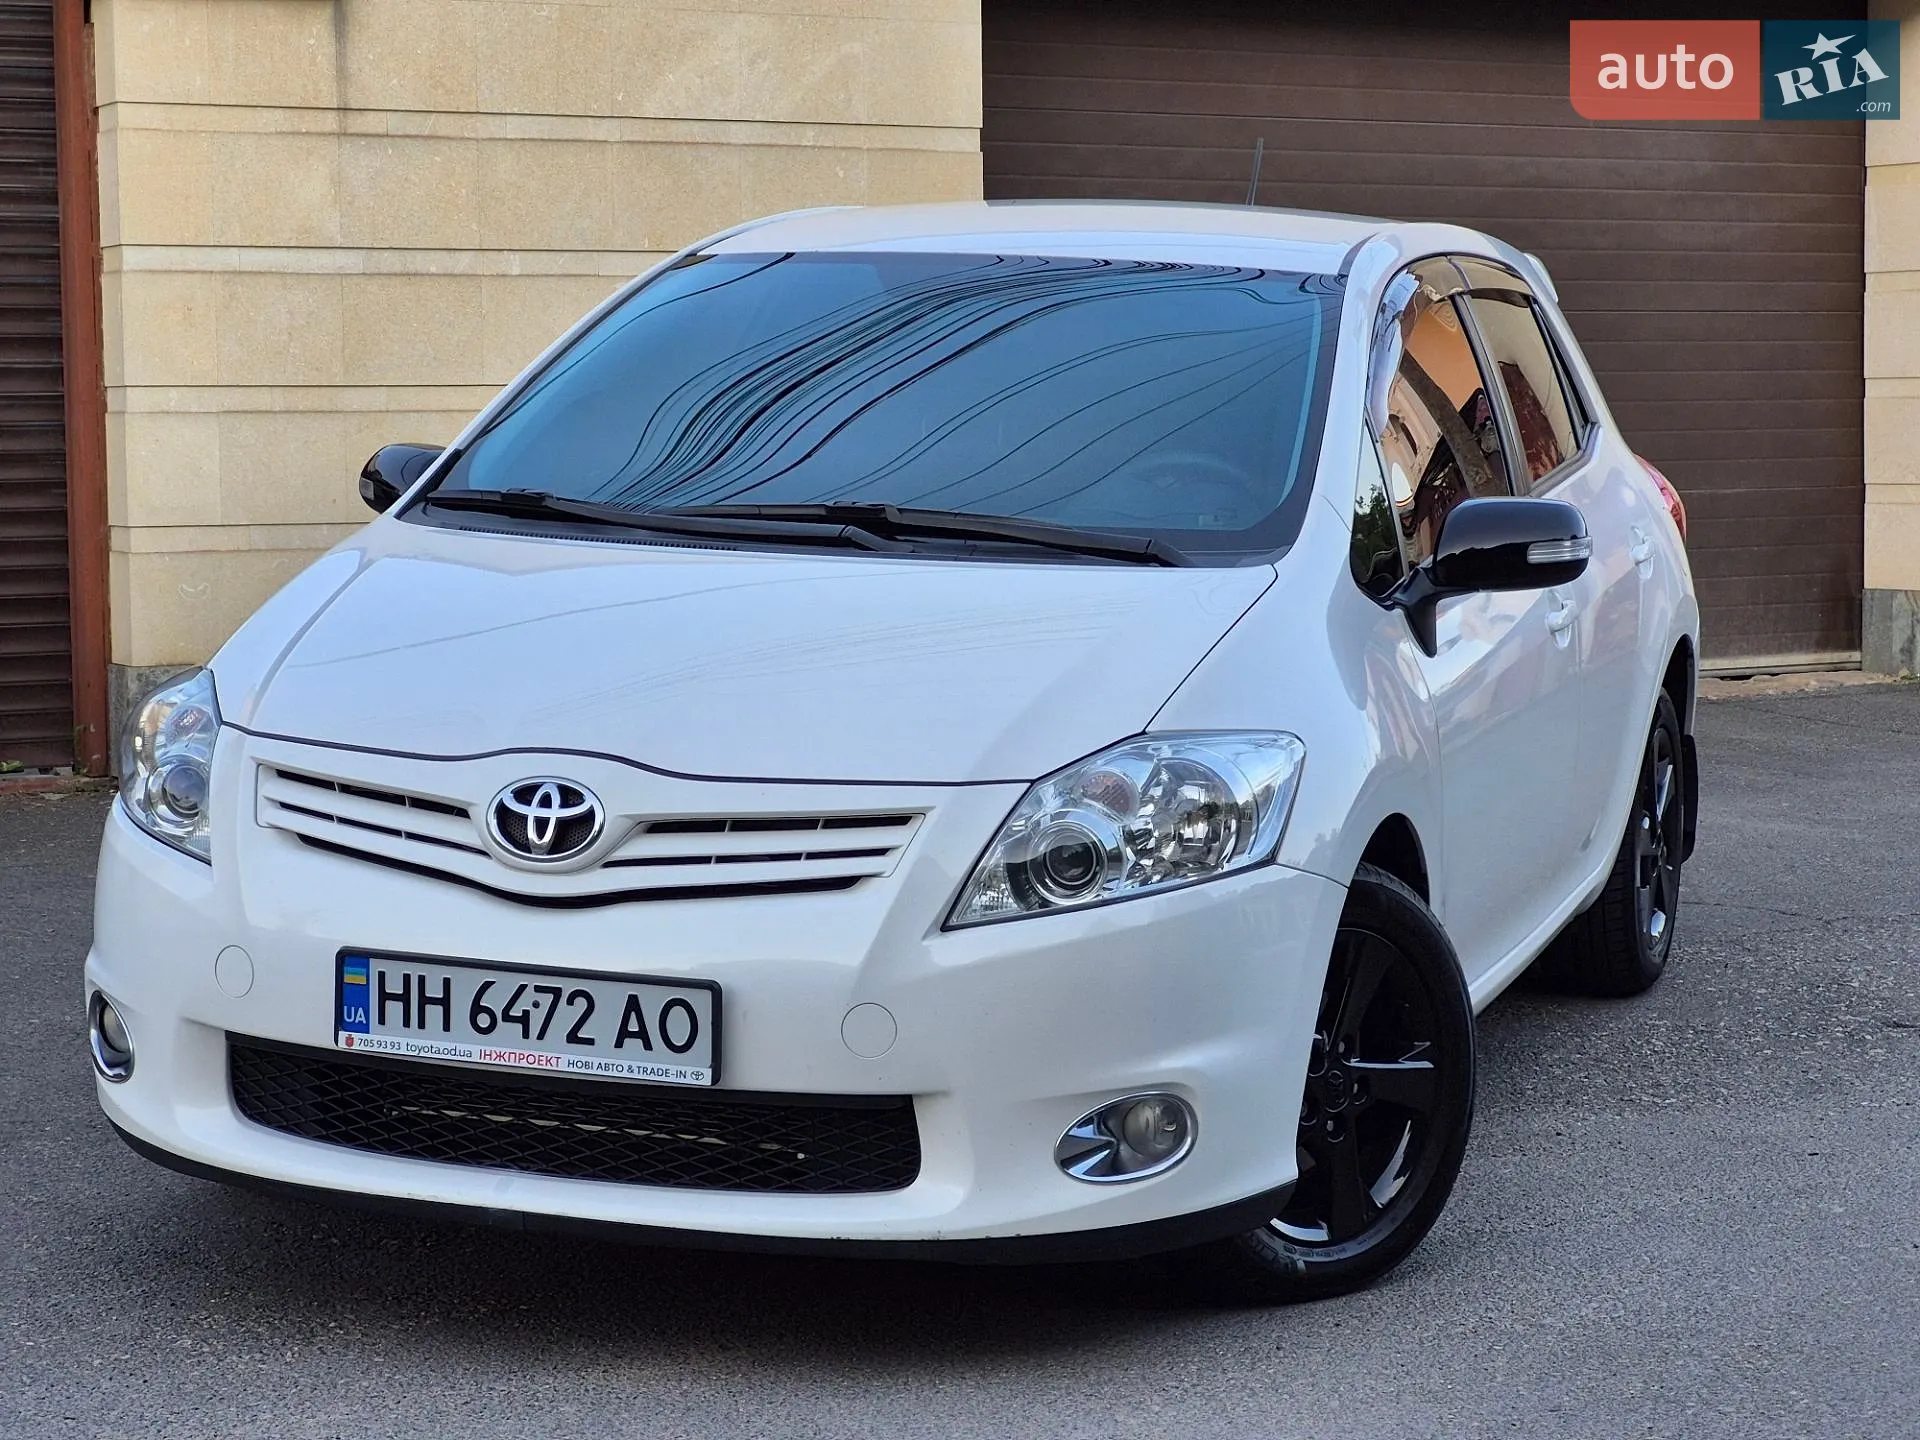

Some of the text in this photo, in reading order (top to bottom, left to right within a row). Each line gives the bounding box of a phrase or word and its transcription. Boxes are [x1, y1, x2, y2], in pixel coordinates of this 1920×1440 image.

[344, 1006, 366, 1024] UA
[377, 970, 699, 1054] HH 6472 AO
[406, 1041, 473, 1058] toyota.od.ua
[479, 1049, 561, 1068] ІНЖПРОЕКТ
[627, 1064, 635, 1074] &
[636, 1065, 687, 1079] TRADE-IN
